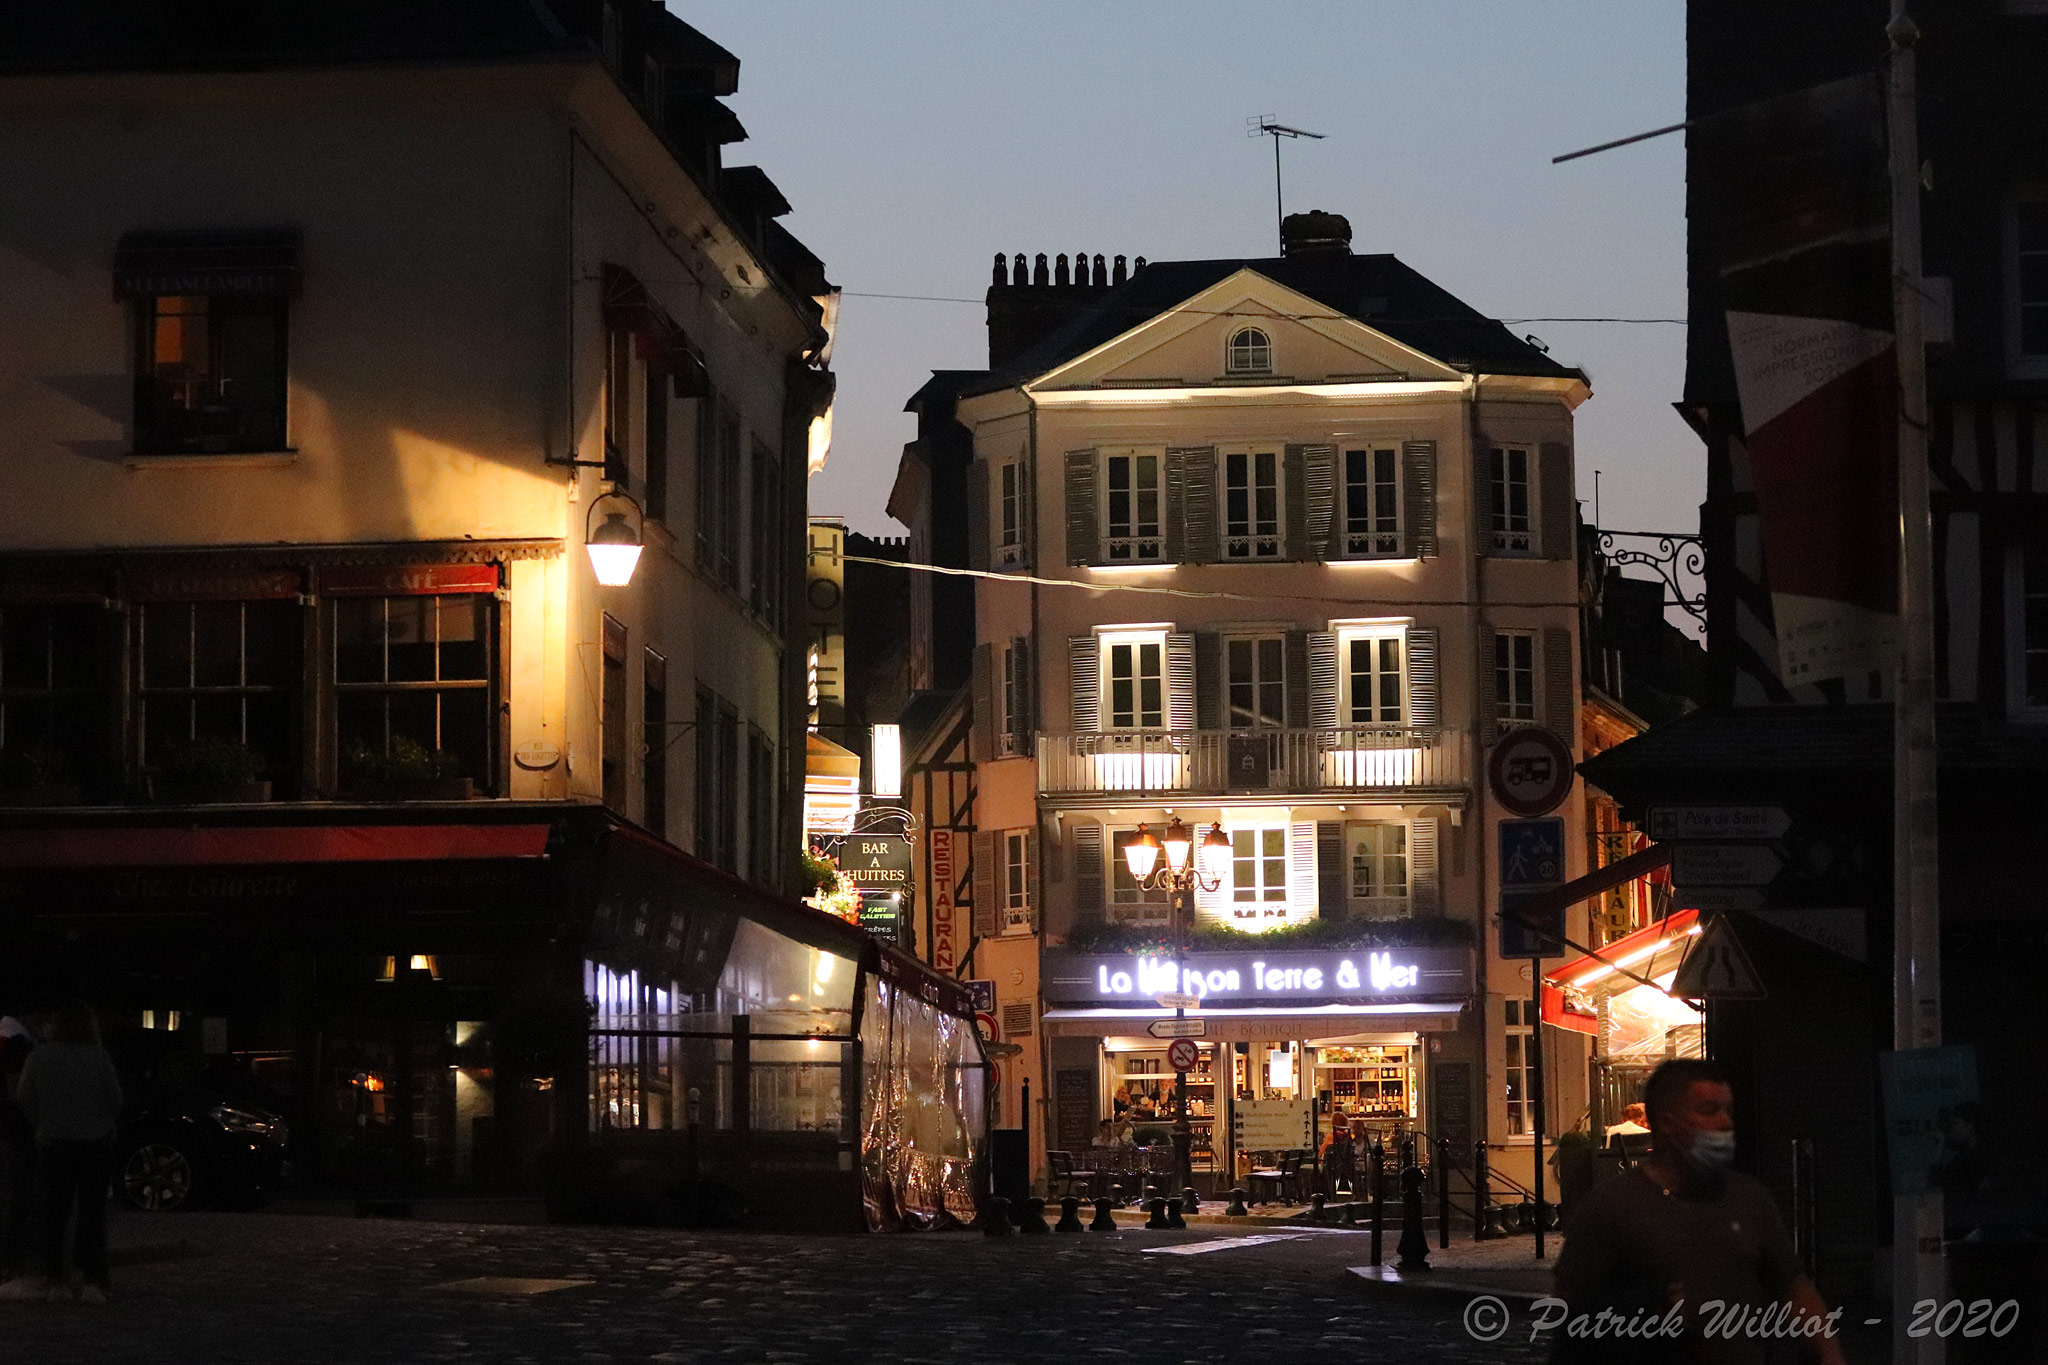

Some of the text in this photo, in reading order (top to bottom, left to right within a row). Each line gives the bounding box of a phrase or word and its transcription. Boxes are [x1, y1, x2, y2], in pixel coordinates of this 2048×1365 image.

[386, 569, 438, 589] CAFÉ
[1685, 811, 1767, 825] Pôle de Santé
[862, 843, 888, 854] BAR
[871, 856, 881, 868] A
[1541, 864, 1554, 874] 20
[847, 870, 905, 881] HUITRES
[1099, 965, 1133, 993] La
[1252, 961, 1323, 991] Terre
[1336, 958, 1361, 991] &
[1369, 951, 1419, 991] Mer
